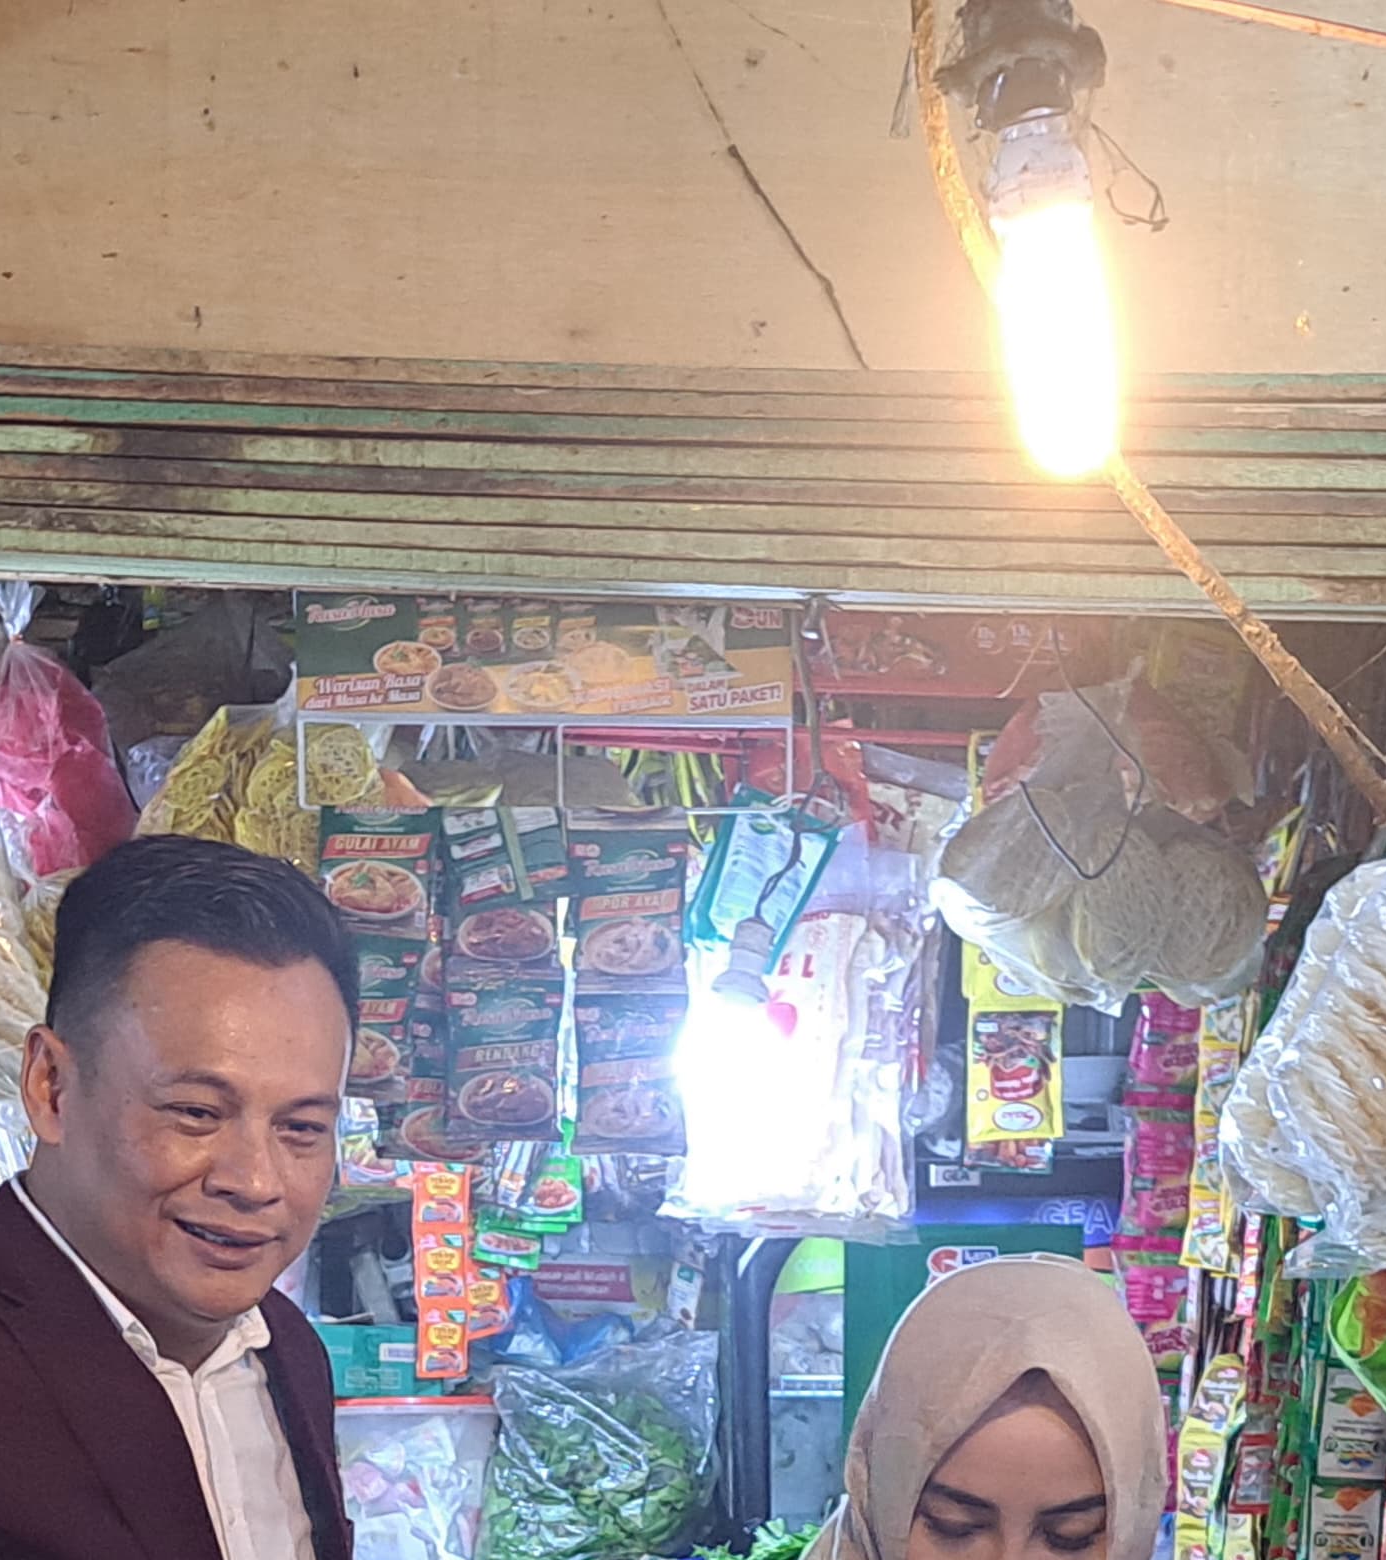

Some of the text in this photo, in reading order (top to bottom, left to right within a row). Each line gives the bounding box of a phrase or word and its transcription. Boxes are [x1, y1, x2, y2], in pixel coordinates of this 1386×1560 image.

[689, 692, 729, 712] SATU
[731, 684, 782, 707] PAKET!
[334, 835, 421, 851] GULAI AYAM
[943, 1169, 970, 1182] GEA
